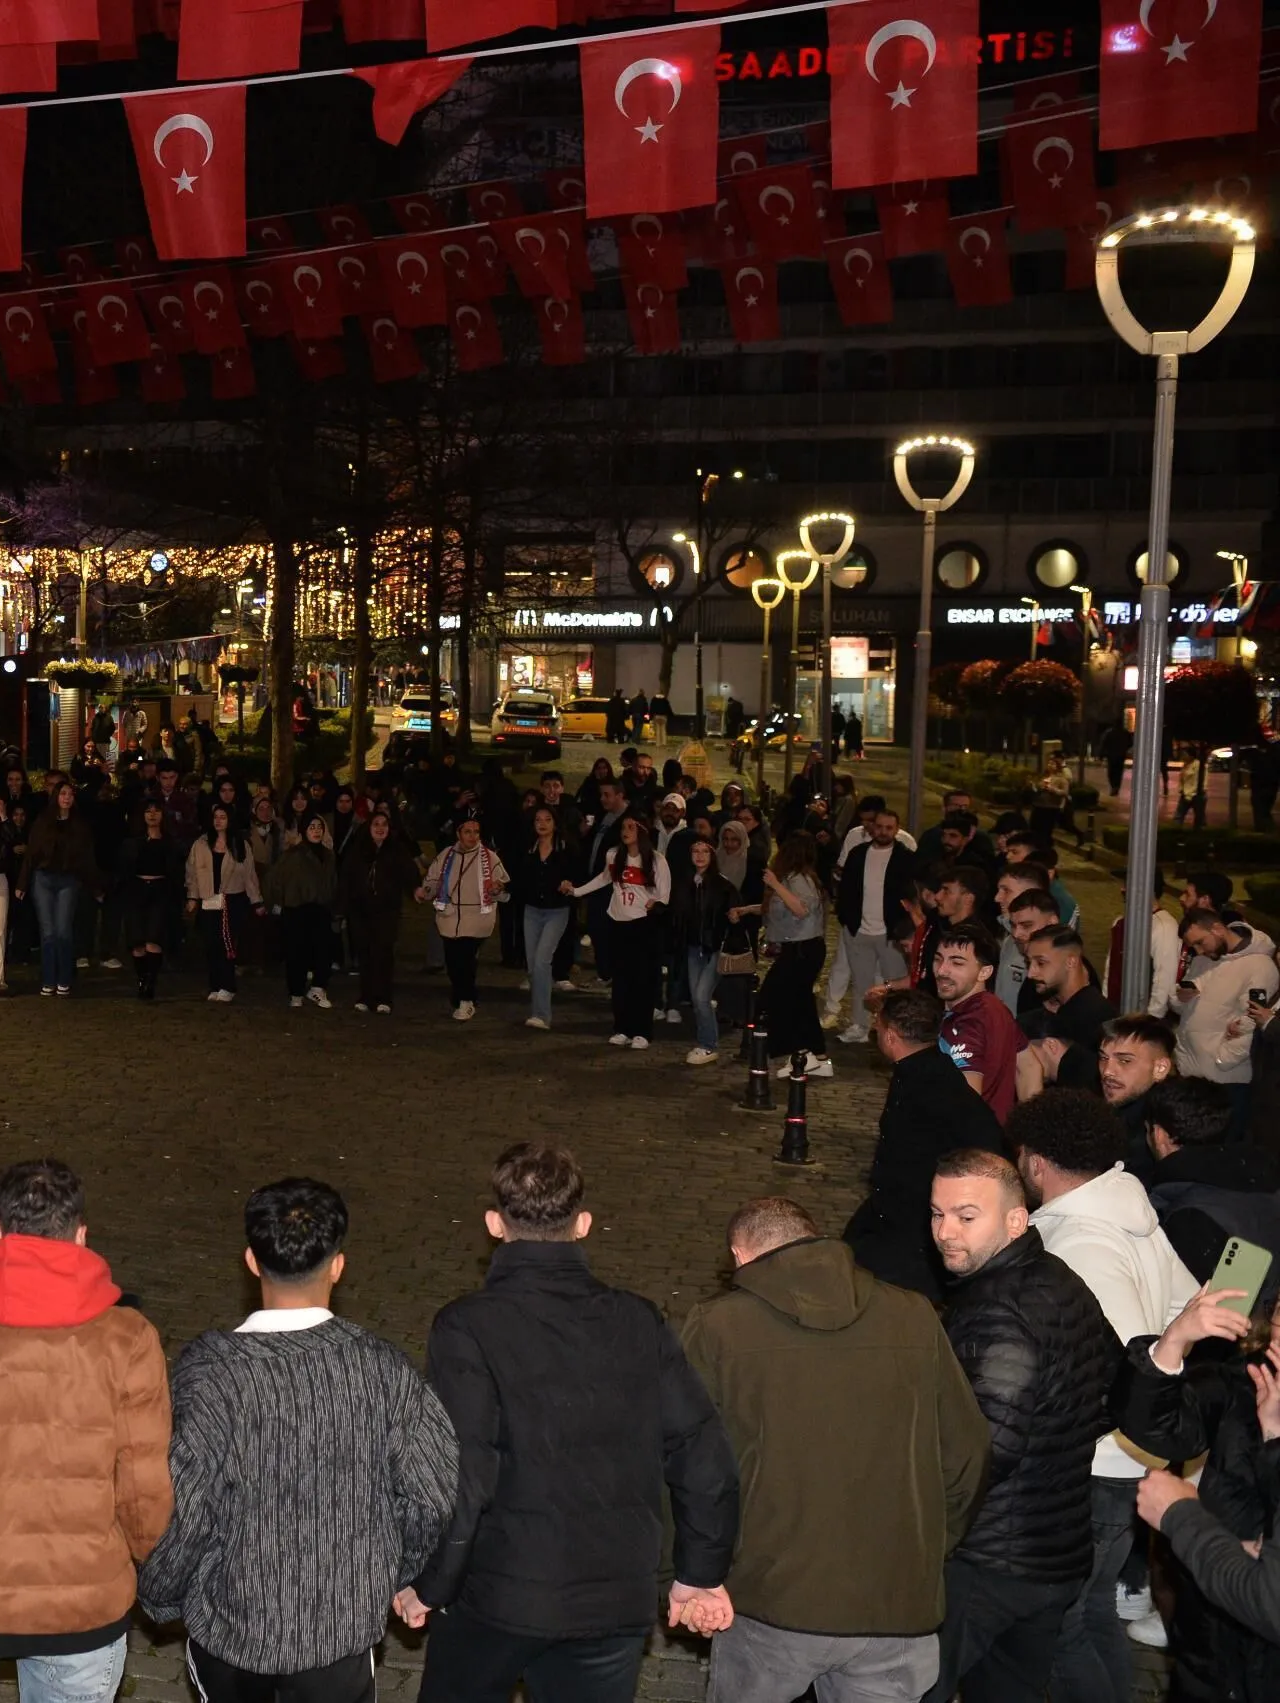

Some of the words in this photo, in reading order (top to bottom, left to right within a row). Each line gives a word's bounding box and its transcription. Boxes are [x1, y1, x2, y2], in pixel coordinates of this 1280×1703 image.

[543, 612, 642, 627] McDonald's
[947, 608, 994, 623] ENSAR
[622, 891, 635, 906] 19
